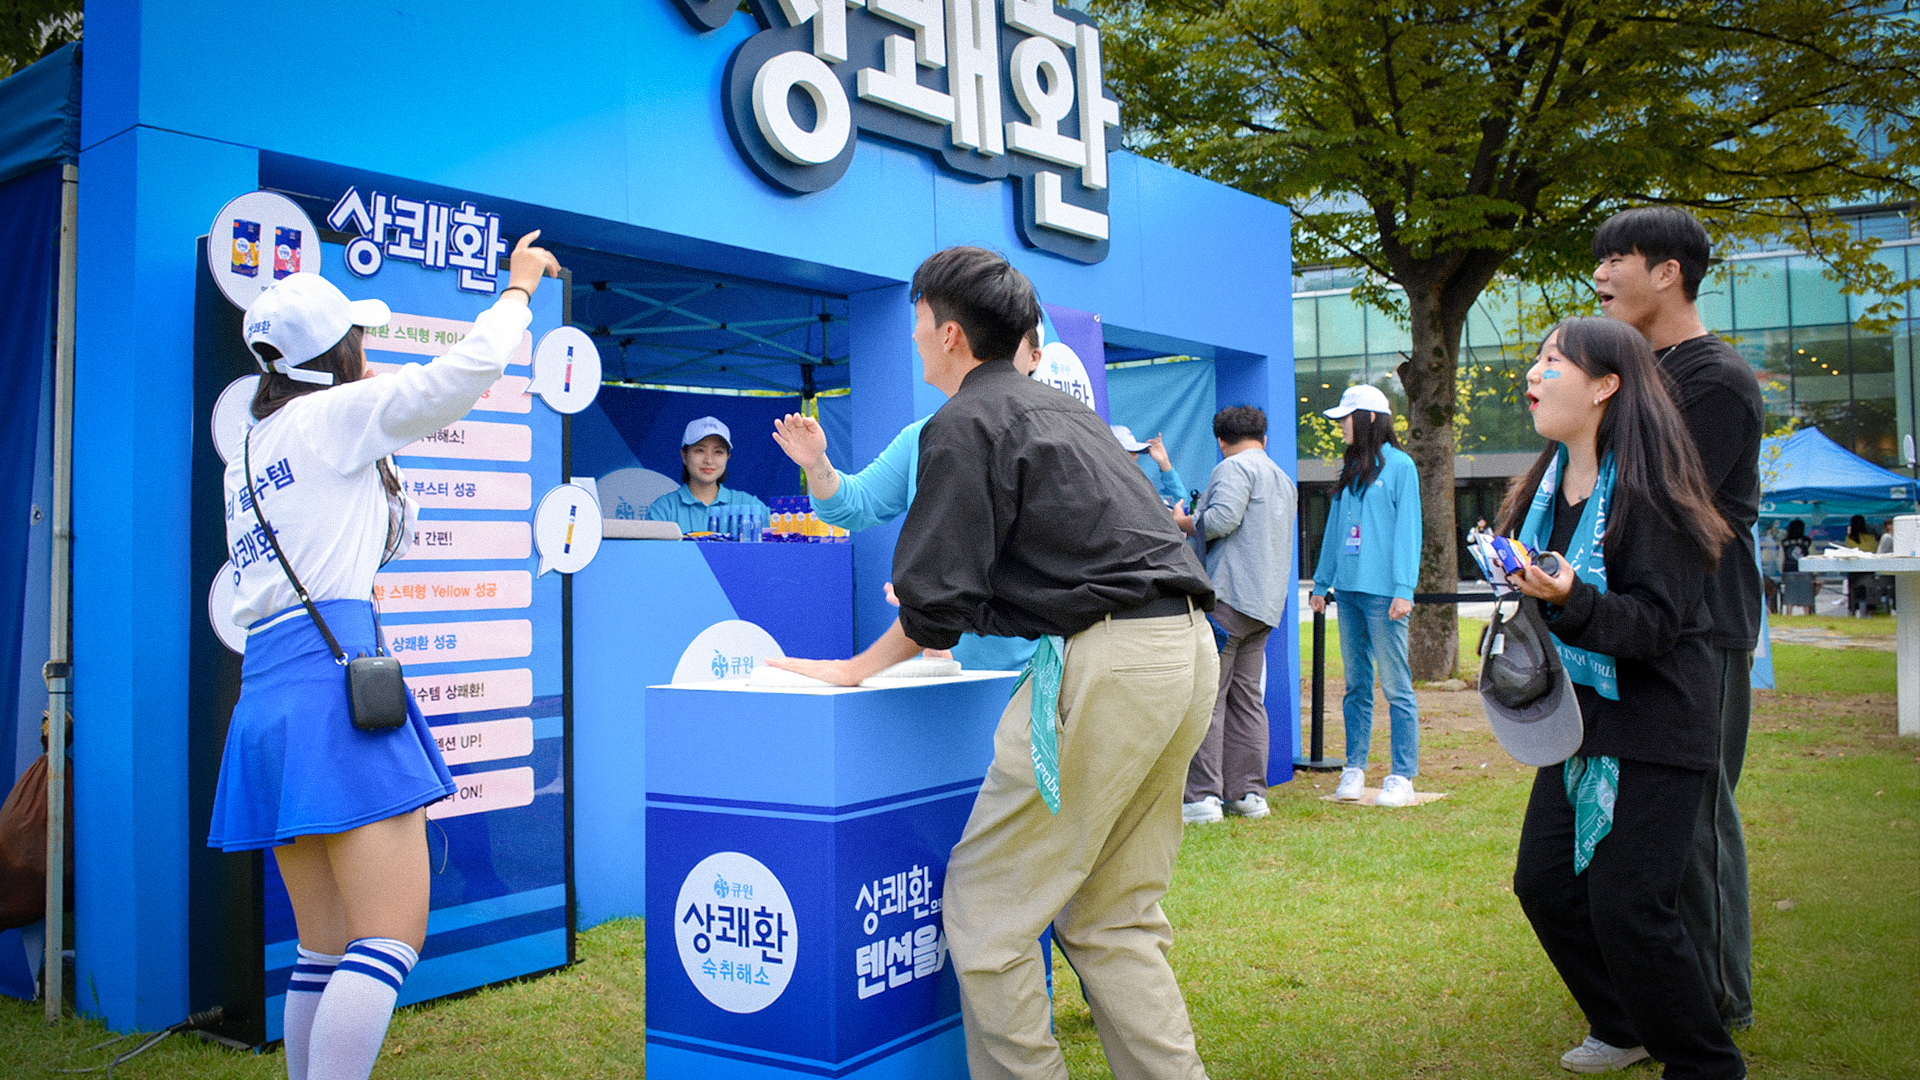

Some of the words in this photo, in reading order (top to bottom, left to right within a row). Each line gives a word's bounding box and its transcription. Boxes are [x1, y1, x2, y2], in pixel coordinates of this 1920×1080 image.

[752, 0, 1120, 240] 상쾌환
[328, 186, 508, 294] 상쾌환
[247, 320, 271, 338] 상쾌환
[394, 326, 430, 344] 스틱형
[413, 482, 449, 497] 부스터
[453, 483, 477, 498] 성공
[425, 531, 453, 546] 간편!
[229, 519, 279, 588] 상쾌환
[389, 584, 427, 599] 스틱형
[431, 584, 471, 598] Yellow
[474, 582, 498, 598] 성공
[392, 635, 429, 653] 상쾌환
[434, 634, 457, 650] 성공
[445, 682, 485, 700] 상쾌환!
[460, 733, 482, 749] UP!
[460, 784, 483, 800] ON!
[731, 882, 754, 900] 큐원
[682, 902, 788, 964] 상쾌환
[702, 957, 770, 986] 숙취해소
